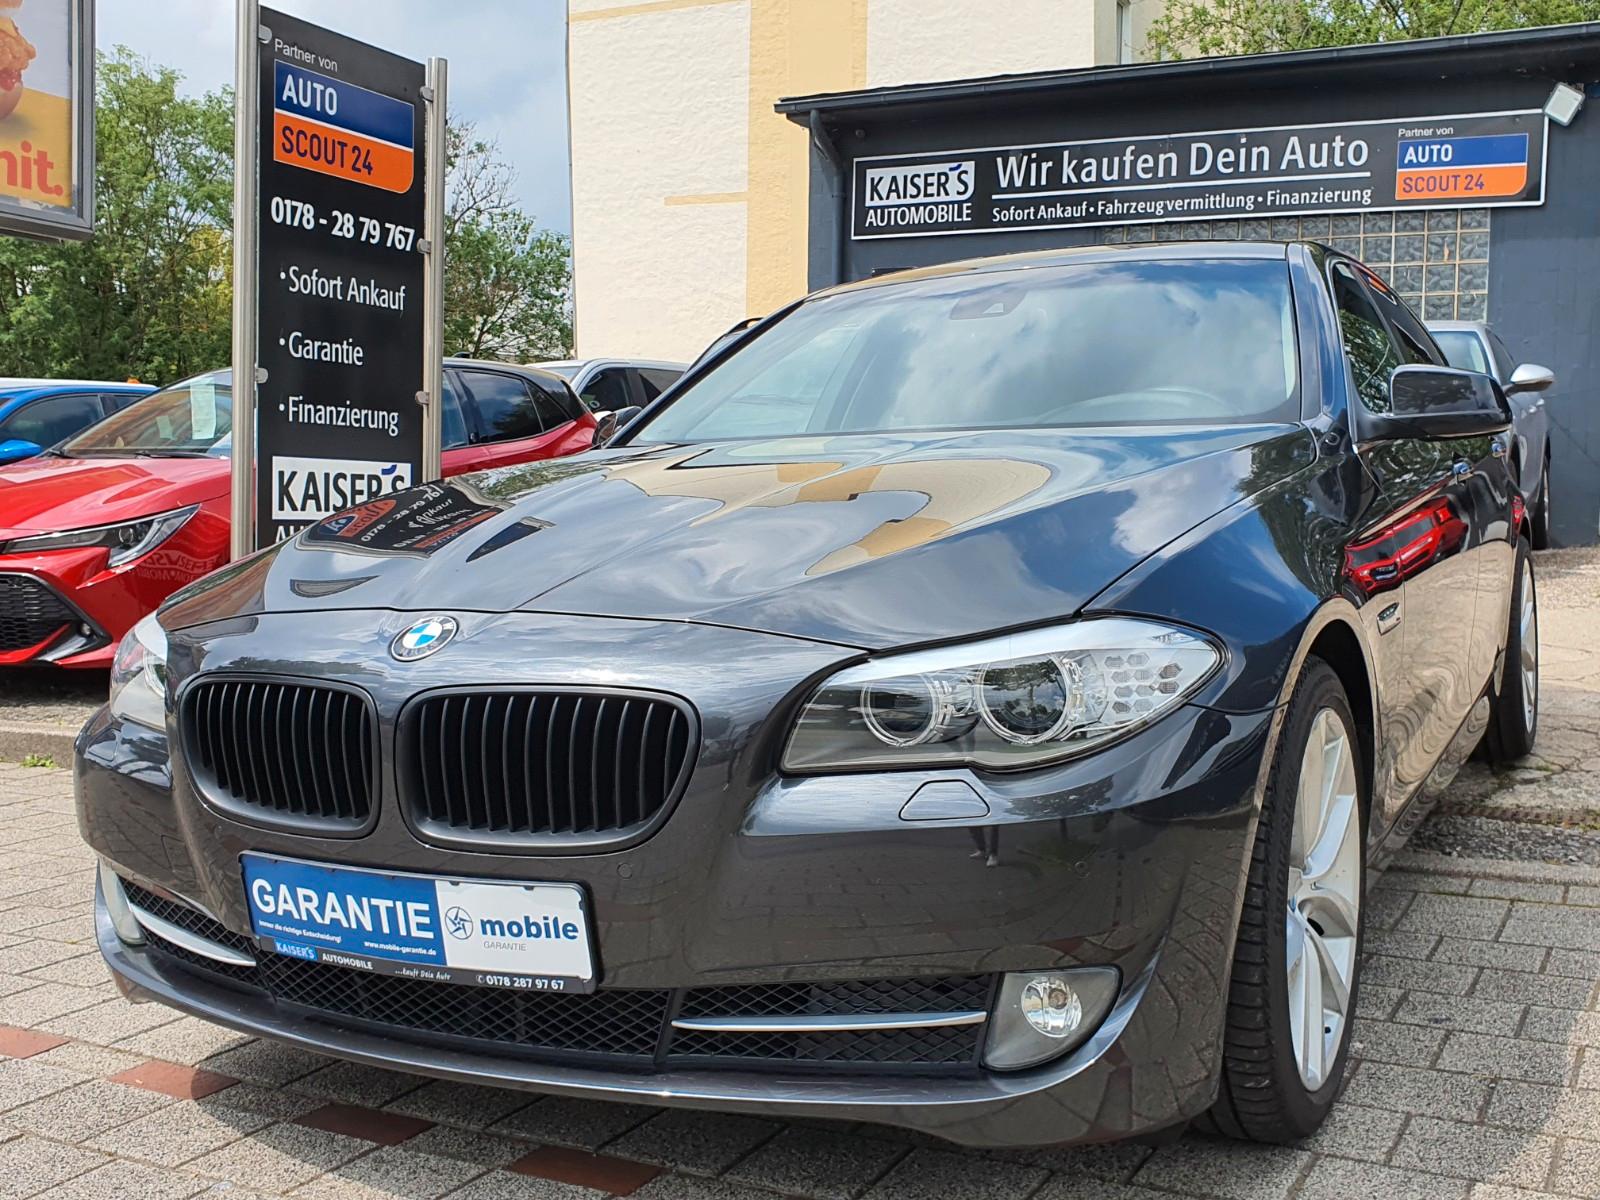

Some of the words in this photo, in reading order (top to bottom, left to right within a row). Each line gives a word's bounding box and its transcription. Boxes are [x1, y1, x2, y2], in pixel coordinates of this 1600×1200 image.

[274, 38, 316, 64] Partner
[318, 55, 338, 72] von
[282, 74, 338, 116] AUTO
[1398, 128, 1433, 138] Partner
[1436, 127, 1454, 135] von
[281, 126, 348, 168] SCOUT
[351, 145, 373, 175] 24
[996, 152, 1053, 188] Wir
[1062, 145, 1178, 184] kaufen
[1189, 137, 1270, 176] Dein
[1280, 135, 1369, 170] Auto
[1403, 144, 1453, 164] AUTO
[1402, 174, 1461, 193] SCOUT
[1464, 173, 1484, 191] 24
[865, 202, 972, 227] AUTOMOBILE
[992, 206, 1035, 222] Sofort
[1037, 201, 1088, 219] Ankauf
[1097, 192, 1255, 215] Fahrzeugvermittlung
[1267, 187, 1371, 205] Finanzierung
[271, 196, 315, 230] 0178
[331, 210, 355, 238] 28
[359, 216, 381, 244] 79
[385, 222, 415, 251] 767
[288, 265, 343, 300] Sofort
[347, 277, 406, 310] Ankauf
[288, 331, 364, 366] Garantie
[288, 396, 399, 437] Finanzierung
[252, 878, 434, 939] GARANTIE
[480, 915, 579, 940] mobile
[322, 953, 374, 970] AUTOMOBILE
[483, 941, 527, 951] GARANTIE
[486, 975, 511, 987] 0178
[513, 977, 532, 988] 287
[535, 979, 548, 989] 97
[551, 980, 564, 990] 67
